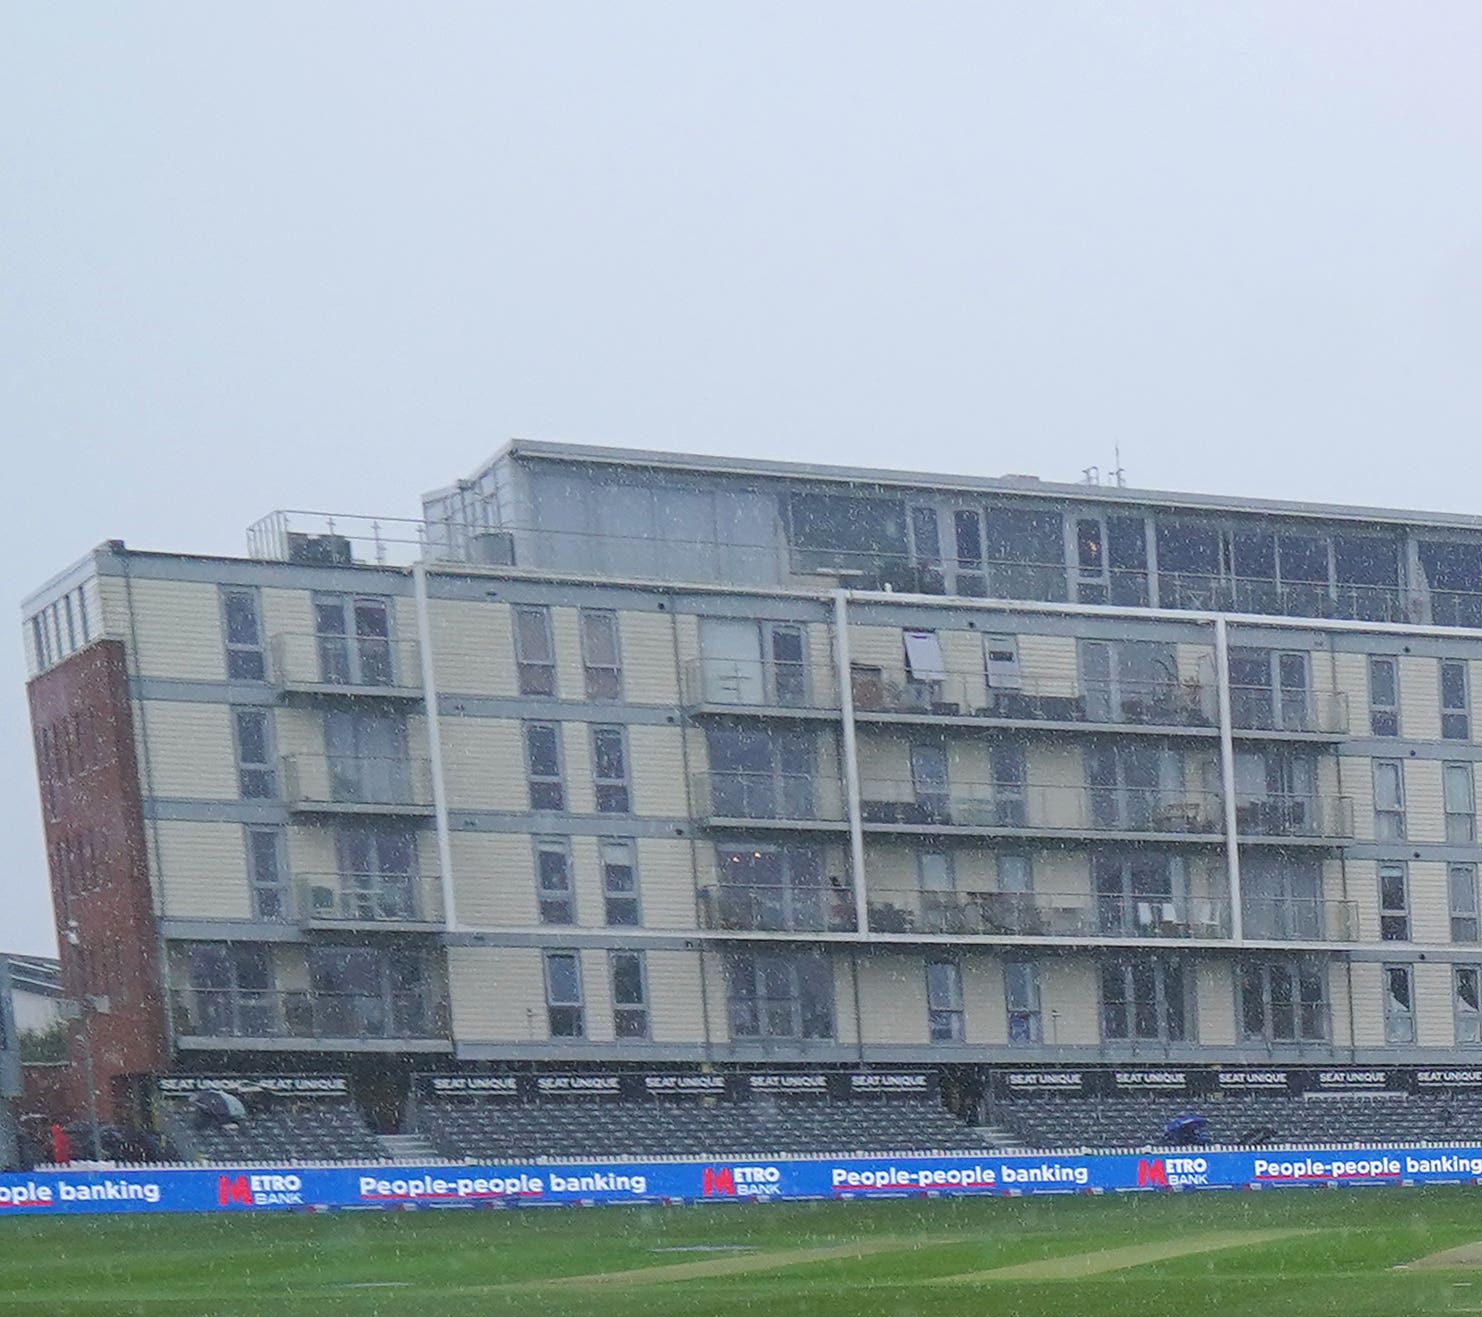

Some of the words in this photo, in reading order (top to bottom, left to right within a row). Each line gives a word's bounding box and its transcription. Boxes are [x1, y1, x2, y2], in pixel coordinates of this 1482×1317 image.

[645, 1077, 676, 1087] SEAT
[677, 1077, 725, 1088] UNIQUE
[750, 1076, 780, 1086] SEAT
[781, 1076, 827, 1087] UNIQUE
[851, 1076, 881, 1086] SEAT
[882, 1076, 927, 1087] UNIQUE
[1010, 1074, 1038, 1084] SEAT
[1039, 1074, 1082, 1085] UNIQUE
[1116, 1073, 1143, 1083] SEAT
[1144, 1073, 1186, 1084] UNIQUE
[1219, 1073, 1246, 1083] SEAT
[1247, 1073, 1287, 1084] UNIQUE
[1320, 1072, 1346, 1082] SEAT
[1347, 1072, 1386, 1083] UNIQUE
[1418, 1072, 1443, 1081] SEAT
[1444, 1072, 1482, 1082] UNIQUE
[434, 1078, 466, 1089] SEAT
[468, 1078, 517, 1089] UNIQUE
[538, 1078, 569, 1088] SEAT
[571, 1078, 620, 1089] UNIQUE
[1138, 1158, 1207, 1186] METRO
[1255, 1158, 1401, 1178] People-people
[1407, 1156, 1482, 1174] banking
[703, 1166, 780, 1195] METRO
[832, 1167, 995, 1187] People-people
[1002, 1164, 1088, 1183] banking
[1167, 1173, 1208, 1185] BANK
[59, 1180, 160, 1201] banking
[219, 1175, 301, 1204] METRO
[359, 1174, 544, 1197] People-people
[550, 1174, 646, 1195] banking
[737, 1184, 781, 1195] BANK
[255, 1193, 304, 1204] BANK
